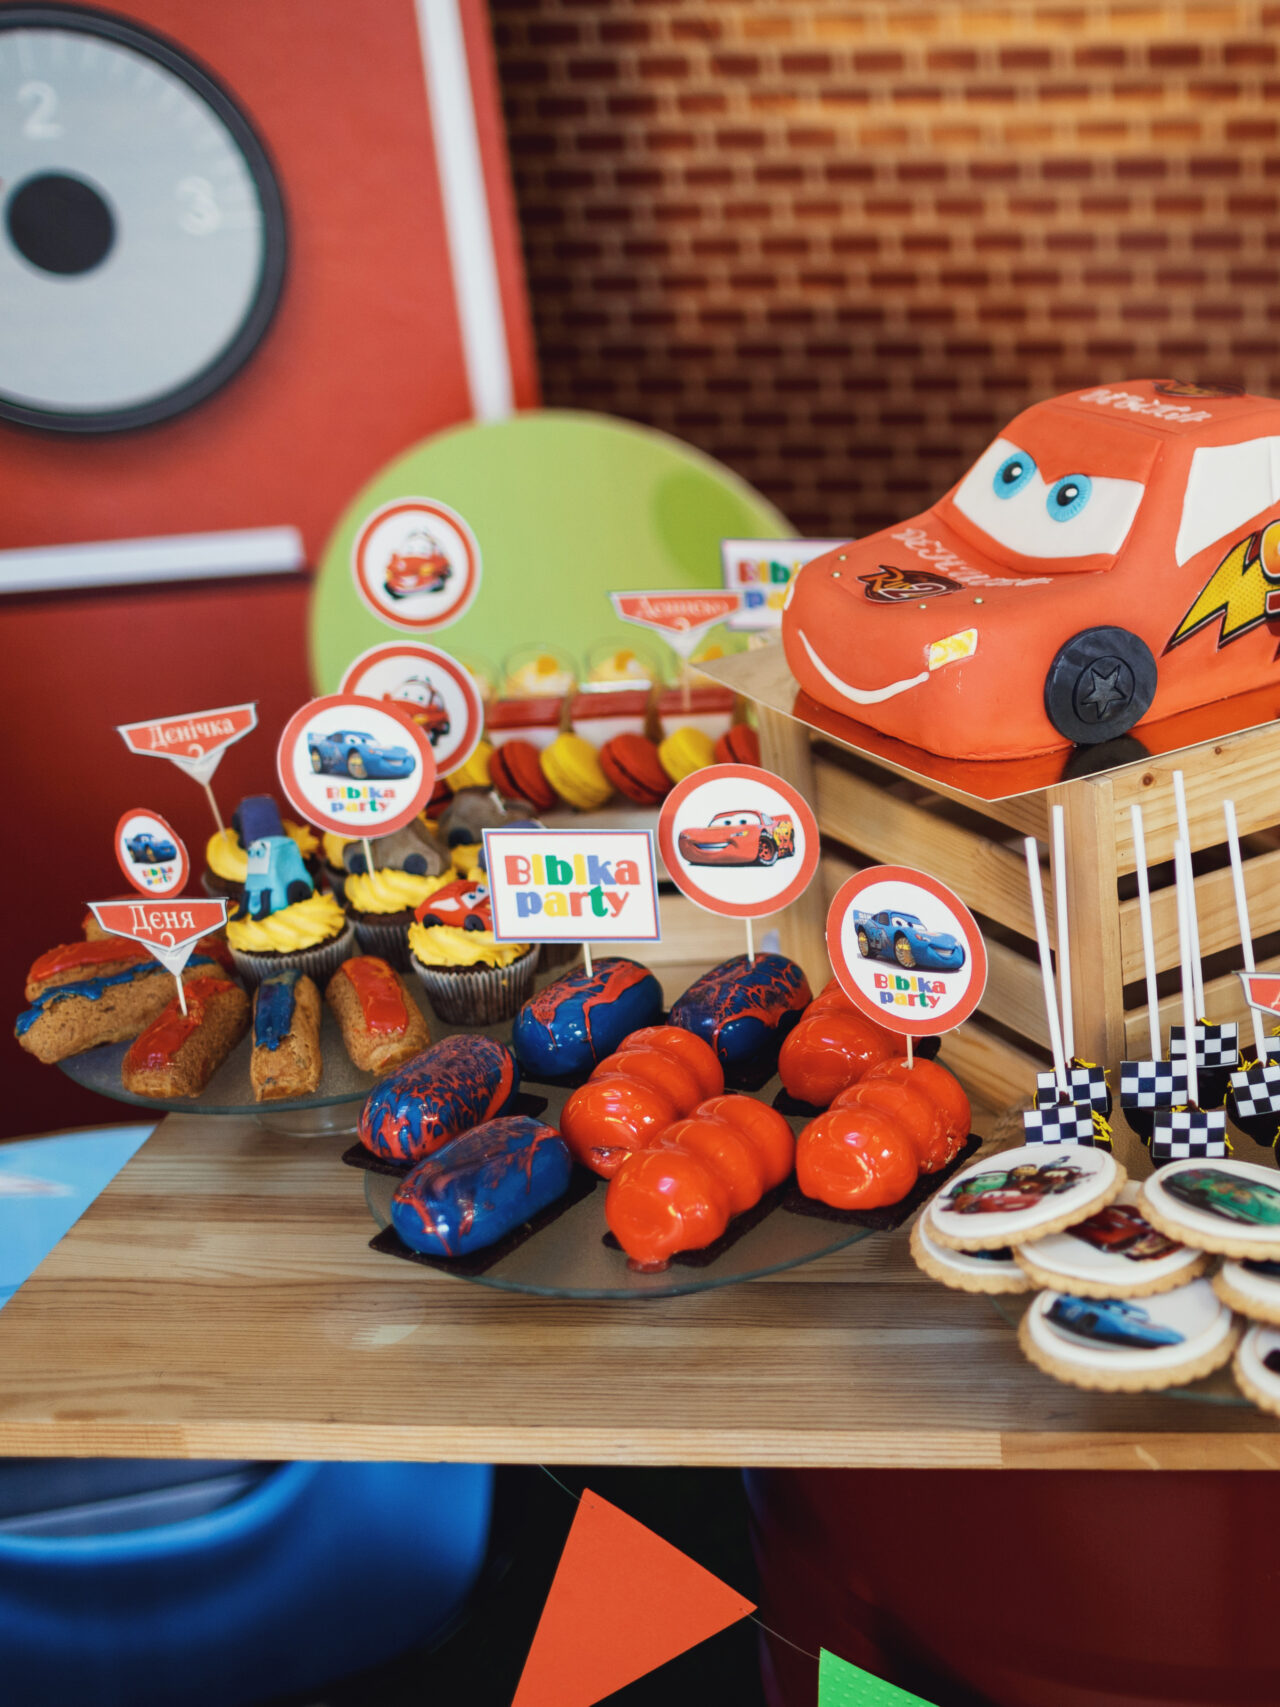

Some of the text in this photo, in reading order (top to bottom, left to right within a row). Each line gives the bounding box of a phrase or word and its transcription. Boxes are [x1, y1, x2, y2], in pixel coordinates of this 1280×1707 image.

[17, 80, 63, 139] 2
[331, 800, 388, 812] party
[516, 885, 629, 918] party
[880, 991, 940, 1008] party
